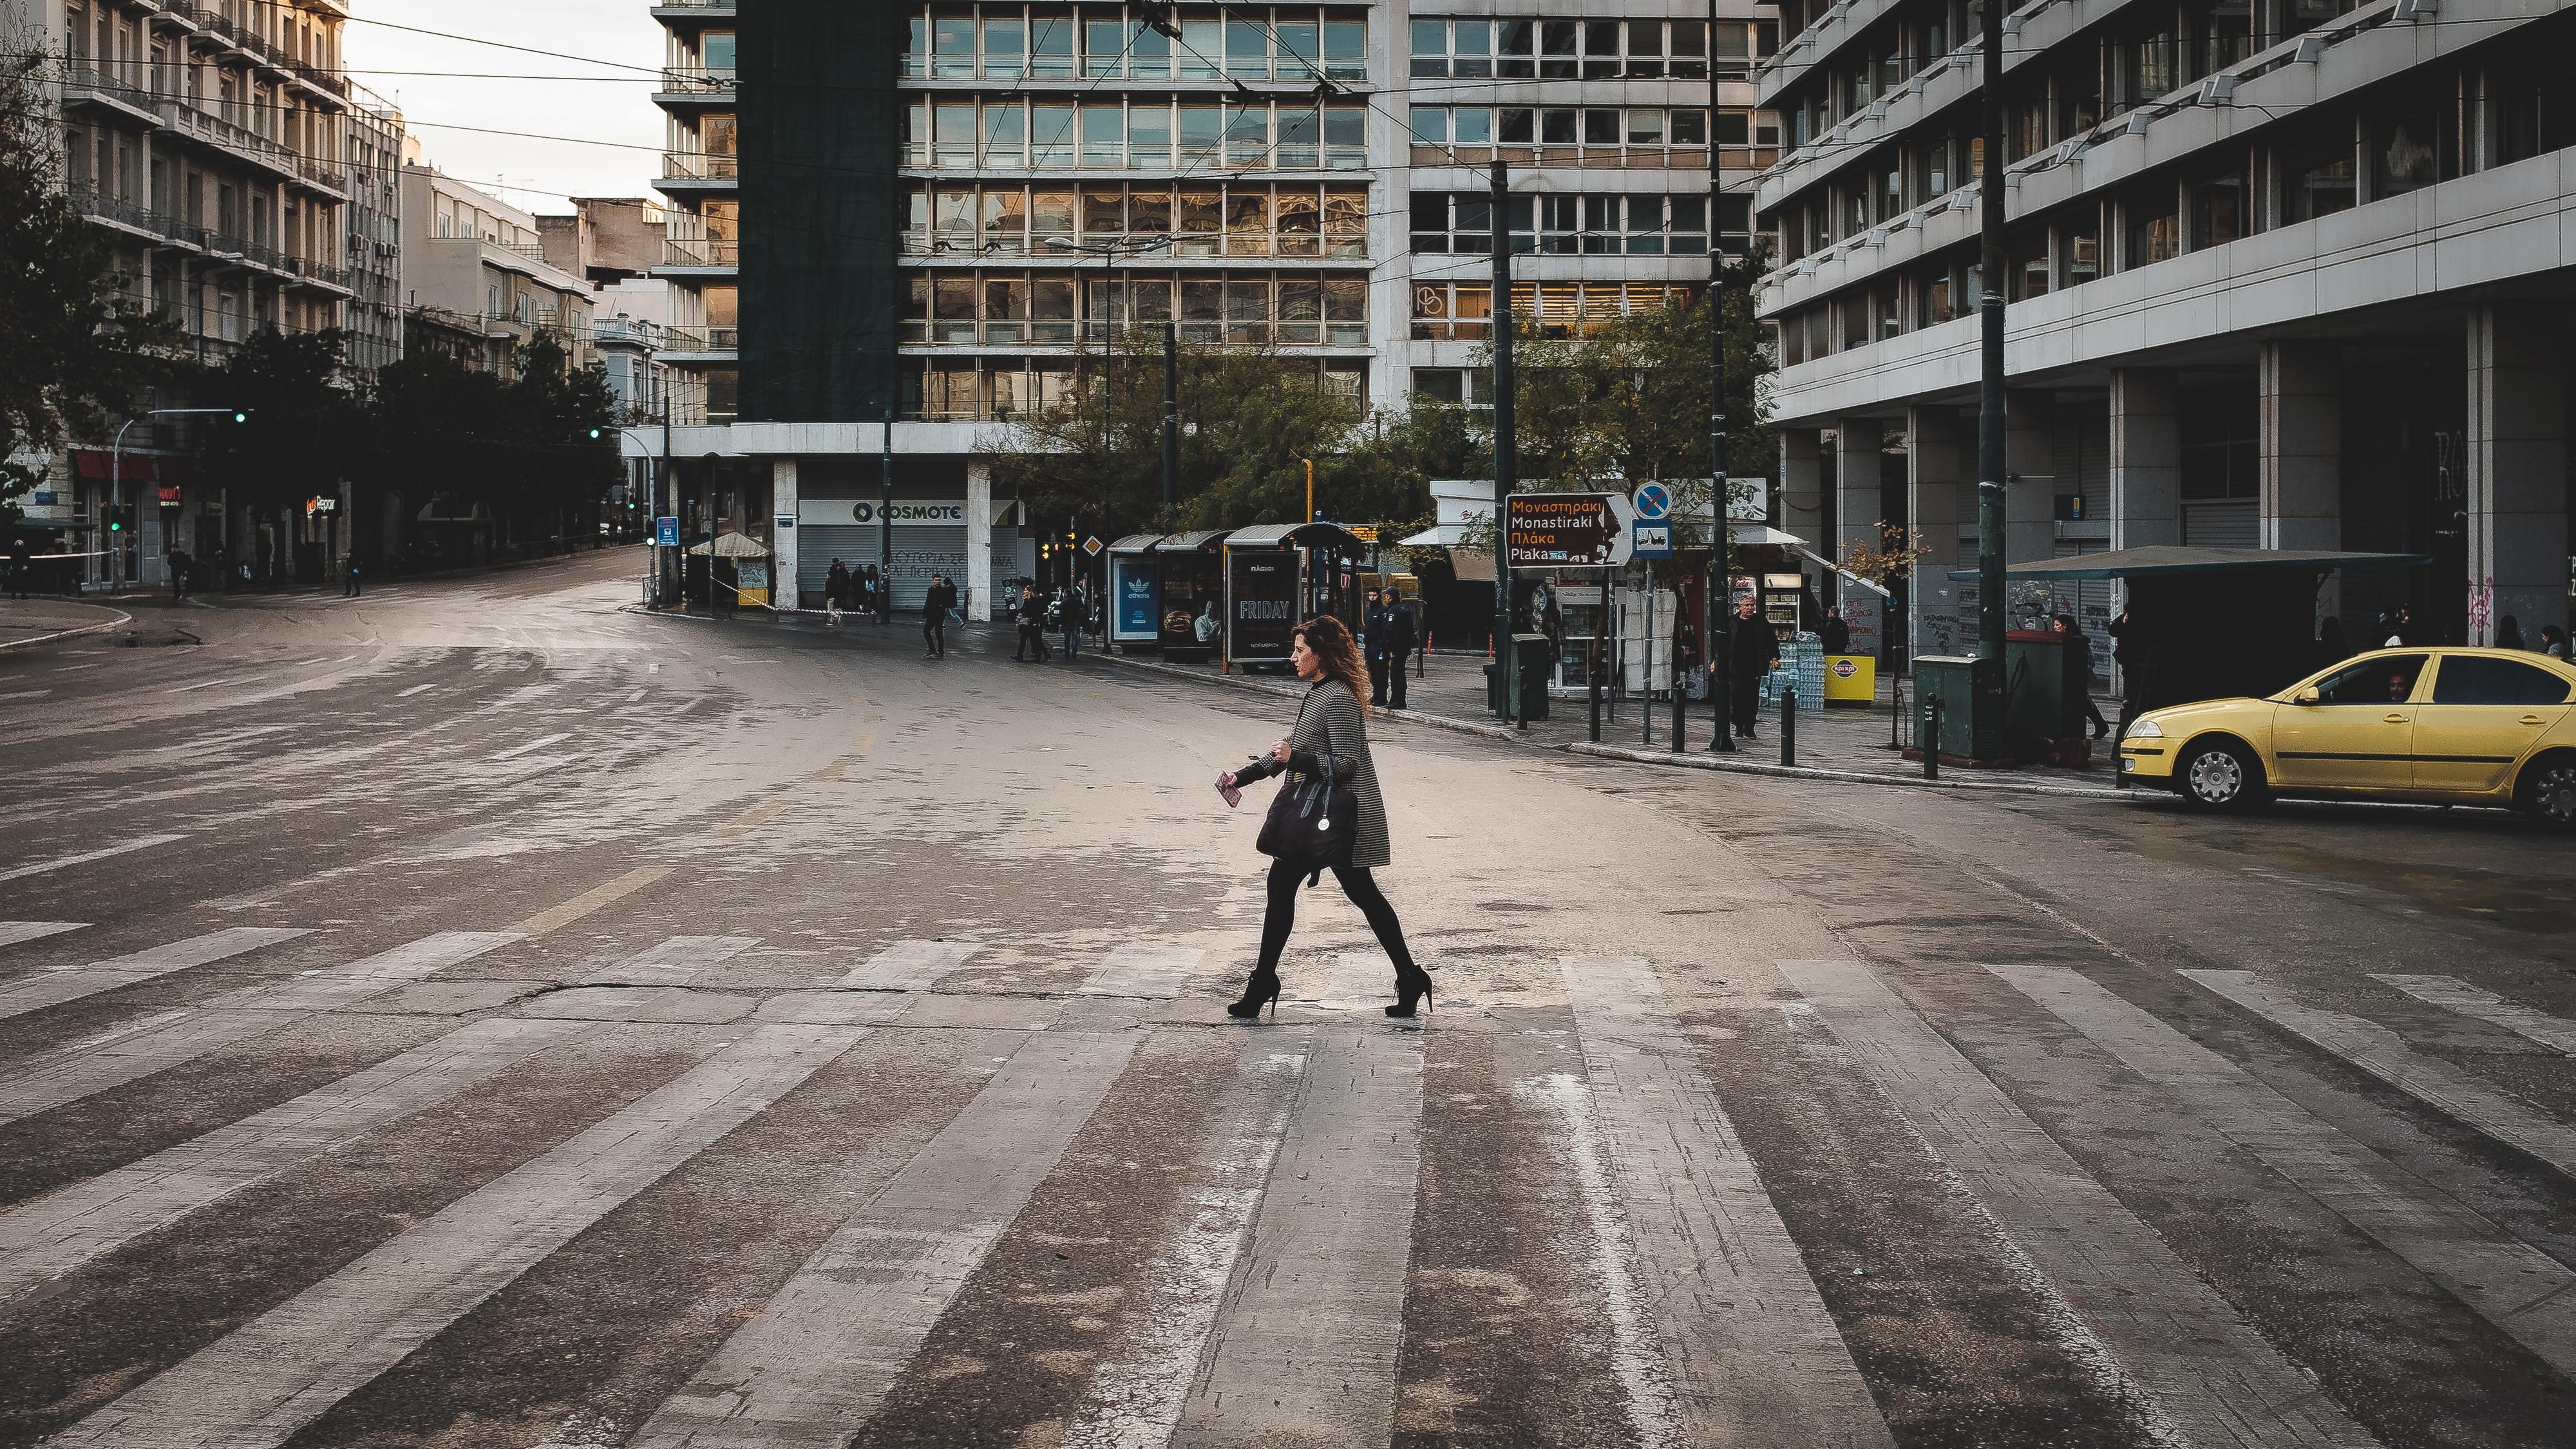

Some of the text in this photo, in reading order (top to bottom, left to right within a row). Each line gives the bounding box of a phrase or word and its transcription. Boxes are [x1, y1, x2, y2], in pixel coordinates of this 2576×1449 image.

[876, 506, 961, 519] COSMOTE
[1512, 500, 1602, 515] Μοναστηράκι
[1511, 516, 1592, 528] Monastiraki
[1511, 532, 1555, 544] Πλάκα
[1511, 548, 1548, 560] Plaka
[1240, 601, 1289, 618] FRIDAY
